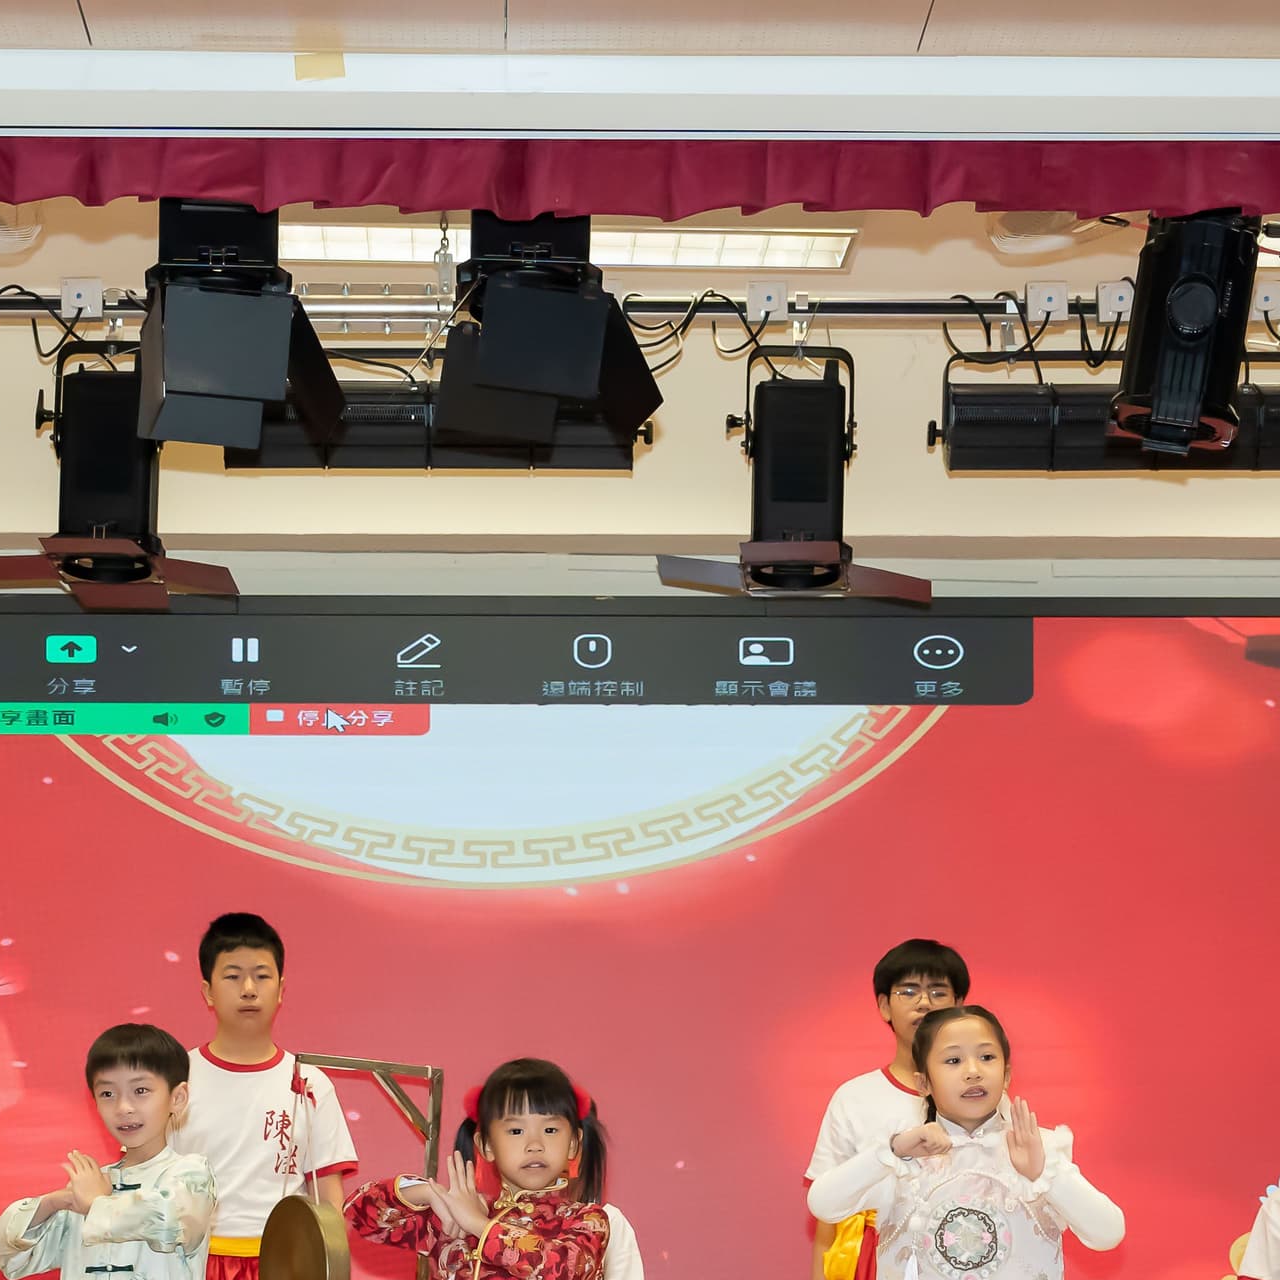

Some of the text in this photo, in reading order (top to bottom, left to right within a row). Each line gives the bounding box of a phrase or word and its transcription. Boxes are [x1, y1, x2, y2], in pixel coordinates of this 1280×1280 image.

[47, 677, 97, 695] 分享
[220, 678, 271, 696] 暫停
[393, 679, 445, 697] 註記
[542, 680, 644, 697] 遠端控制
[714, 680, 817, 697] 顯示會議
[914, 681, 964, 698] 更多
[297, 709, 394, 728] 停分享
